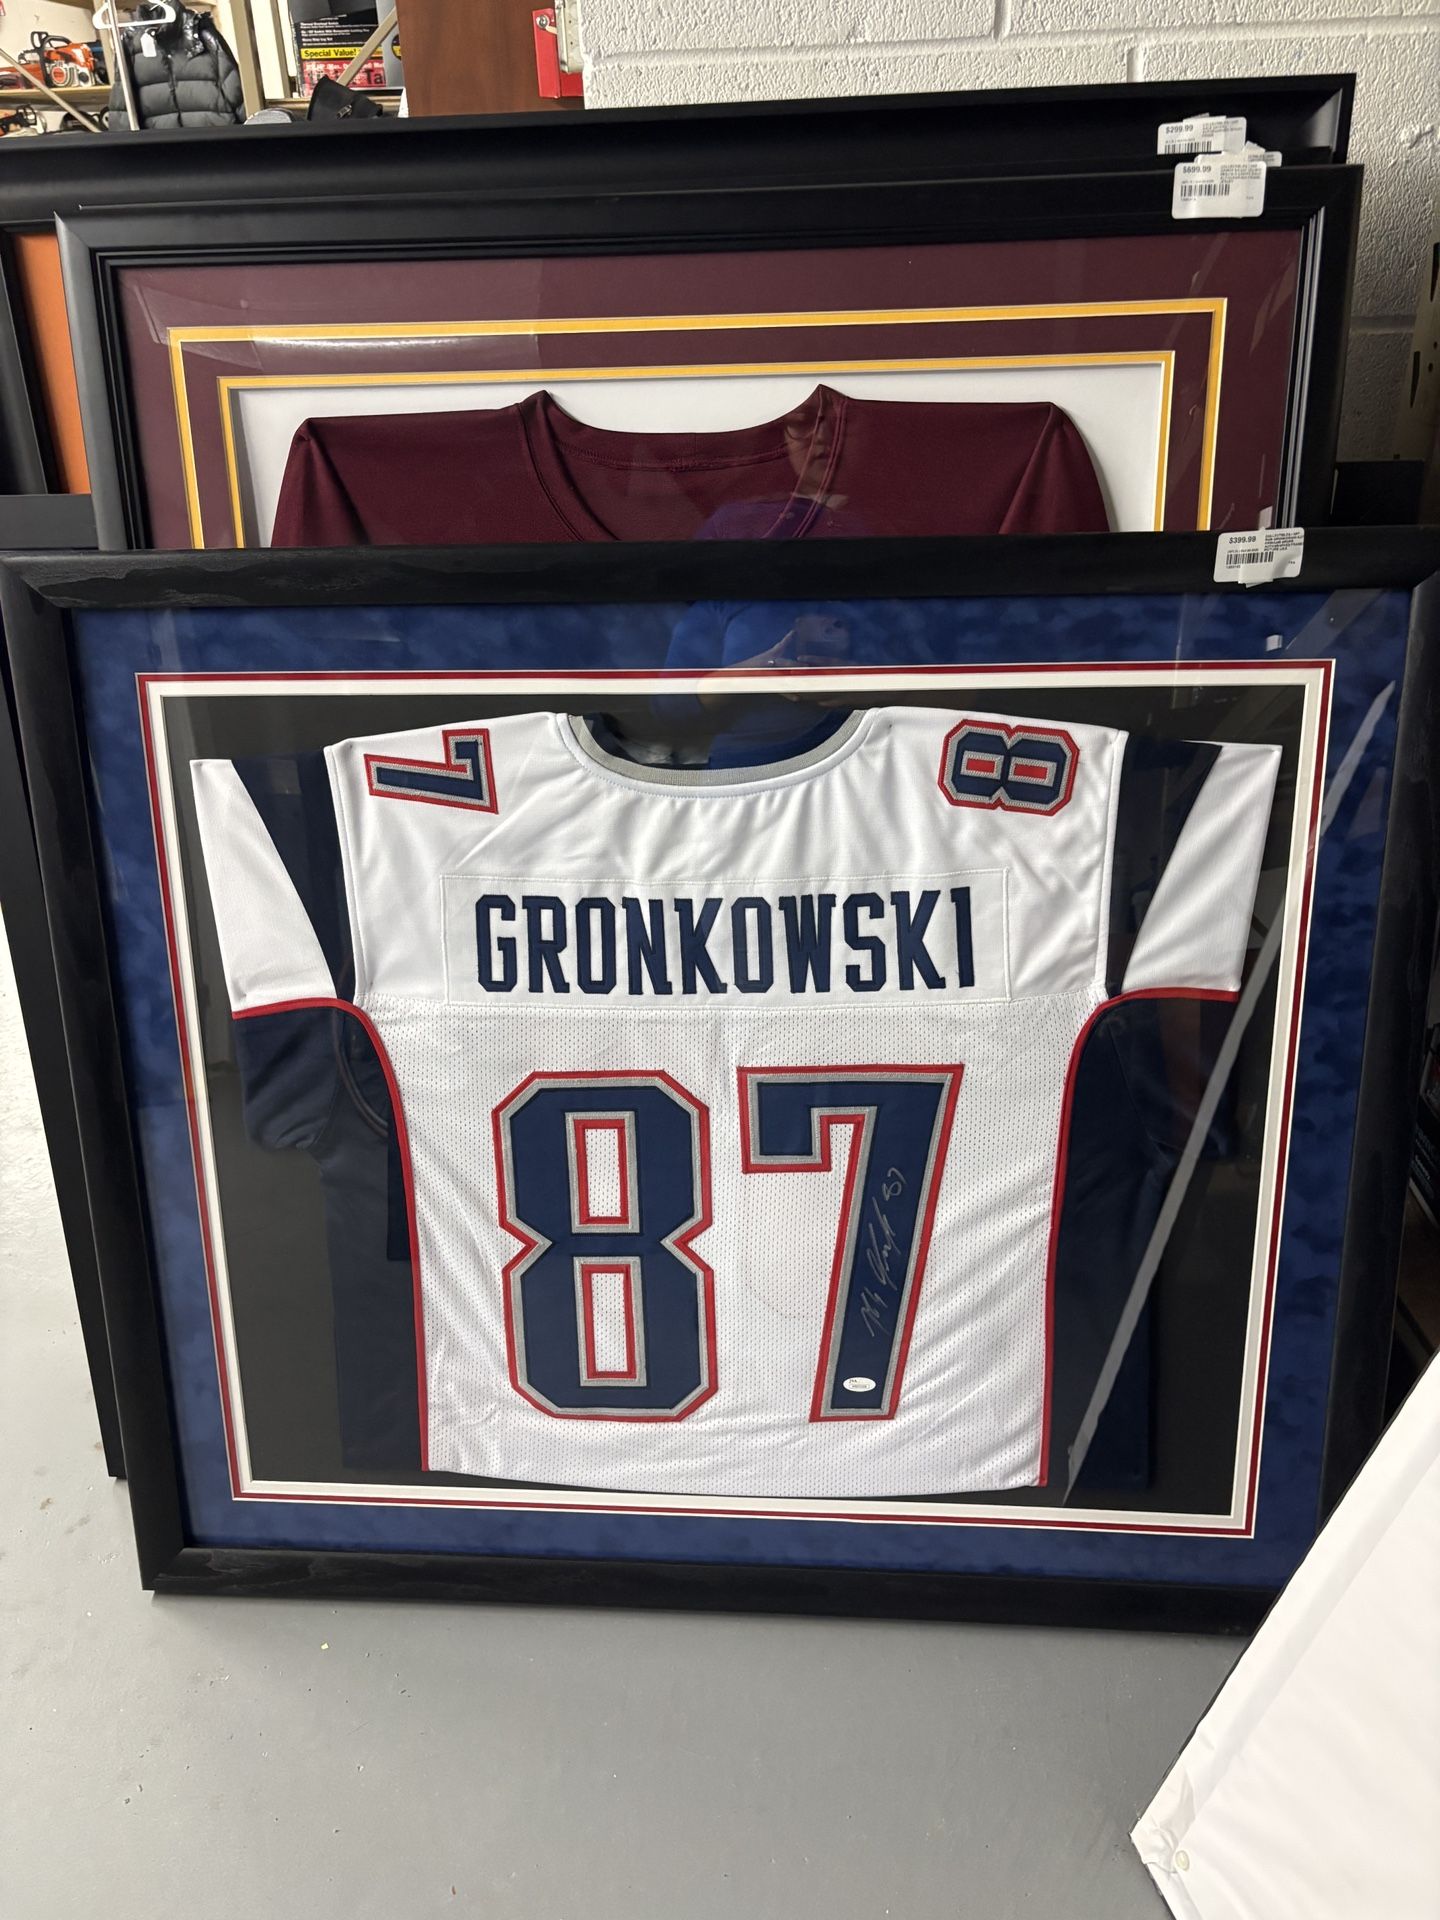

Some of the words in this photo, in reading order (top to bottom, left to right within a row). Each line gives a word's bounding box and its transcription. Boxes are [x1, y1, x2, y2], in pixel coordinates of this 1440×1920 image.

[304, 49, 331, 57] Special
[334, 48, 356, 56] Value!
[1166, 124, 1193, 134] $299.99
[1229, 536, 1256, 544] $399.99
[365, 727, 499, 814] 7
[938, 718, 1081, 816] 8
[474, 886, 975, 995] GRONKOWSKI
[491, 1063, 964, 1423] 87
